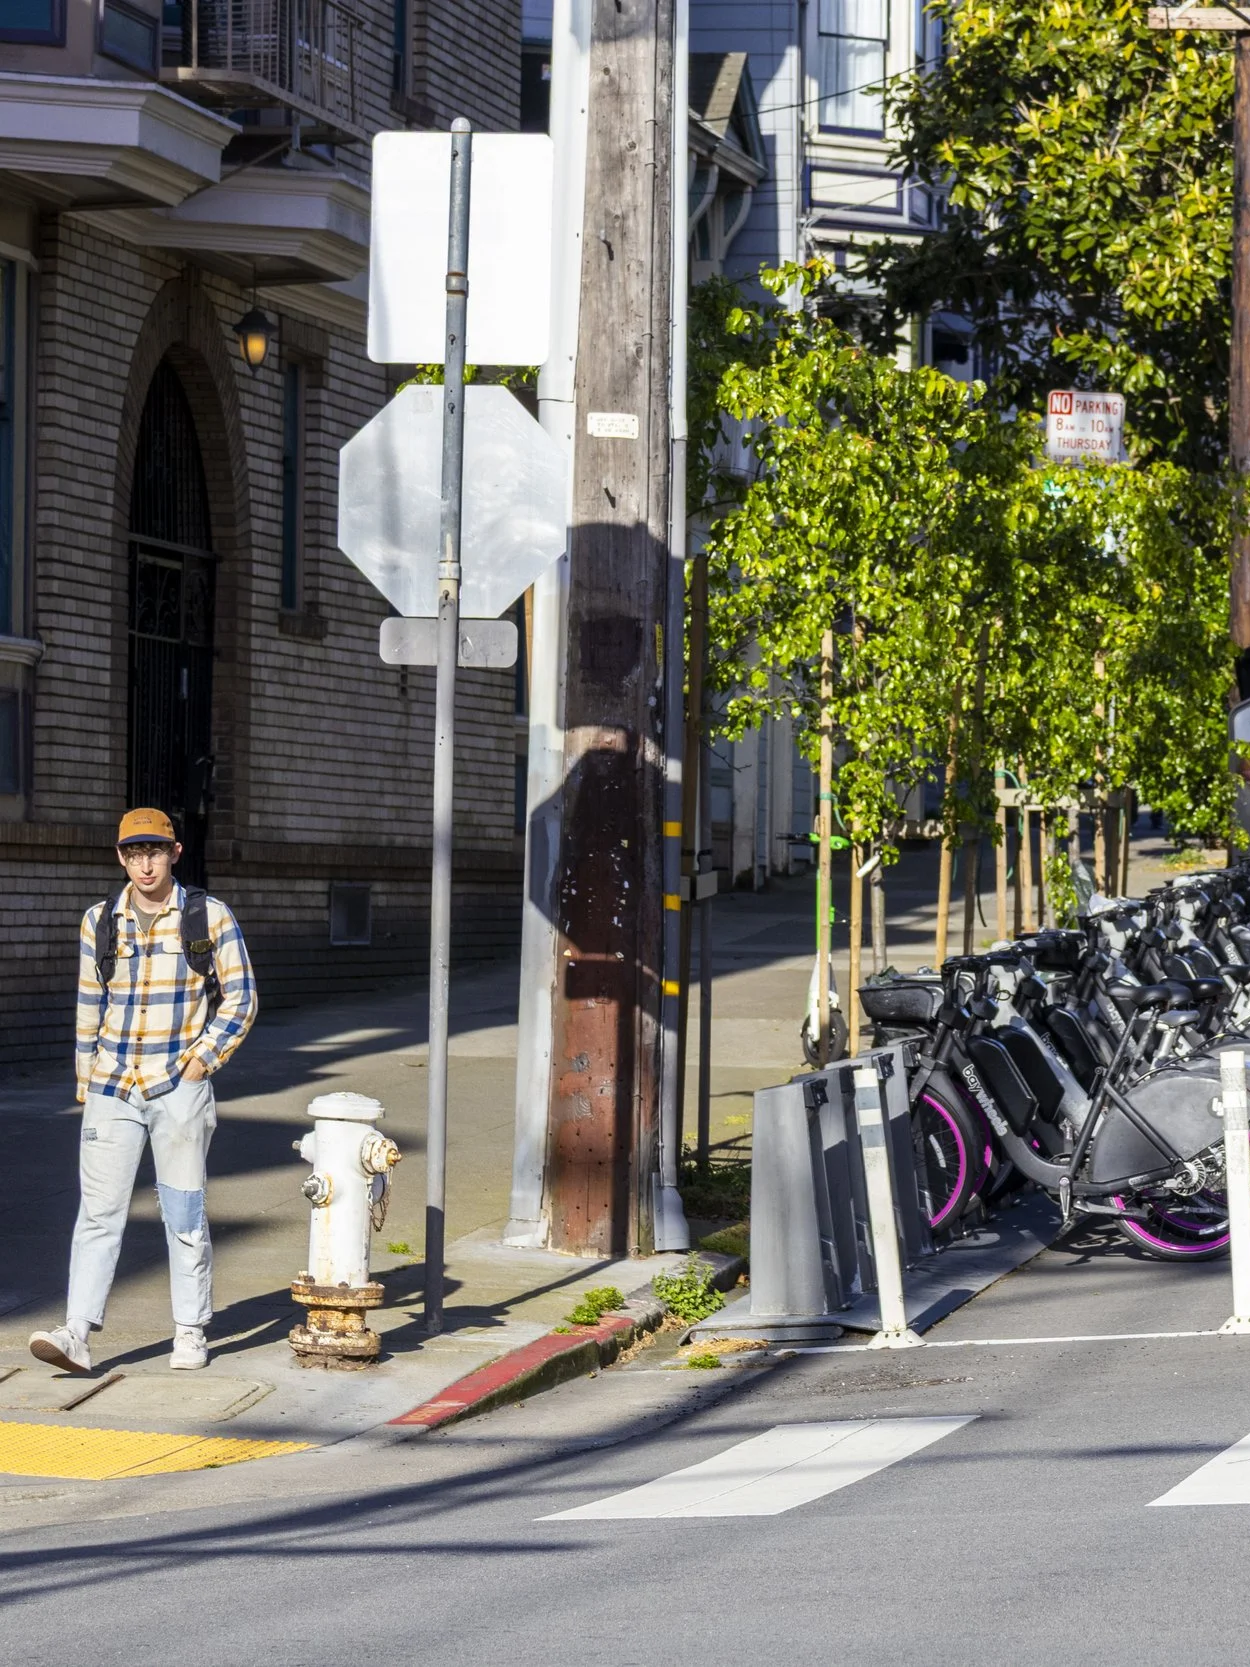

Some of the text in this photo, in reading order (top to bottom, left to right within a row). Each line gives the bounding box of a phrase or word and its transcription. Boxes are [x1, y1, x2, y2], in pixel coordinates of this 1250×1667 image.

[1051, 393, 1119, 415] NO PARKING
[1057, 437, 1112, 450] THURSDAY
